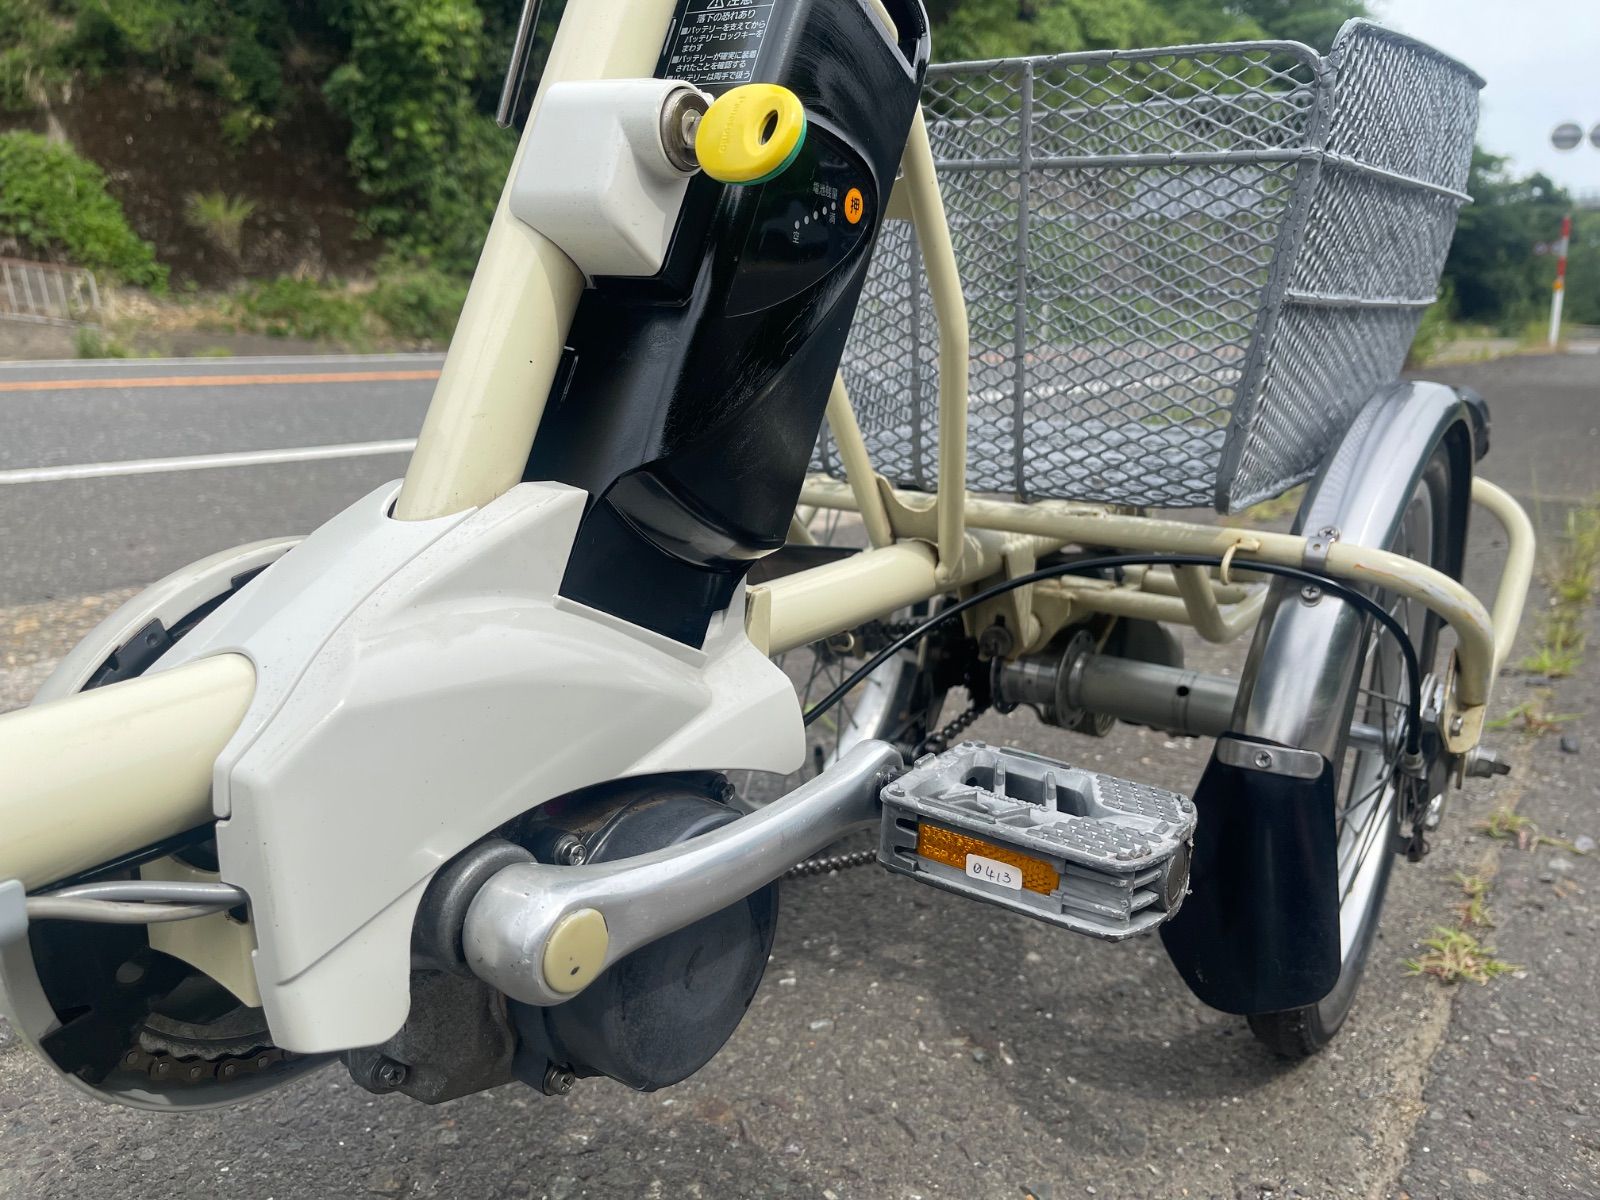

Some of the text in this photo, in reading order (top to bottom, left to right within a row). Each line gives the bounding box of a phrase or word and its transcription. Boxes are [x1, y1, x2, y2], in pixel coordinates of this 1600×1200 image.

[696, 9, 755, 23] 落下の恐れあり
[687, 20, 766, 34] バッテリーを支えてから
[684, 29, 764, 43] バッテリーロックキーを
[681, 43, 703, 53] まわす
[679, 50, 757, 63] バッテリーが確実に装着
[675, 60, 746, 72] されたことを確認する
[850, 196, 860, 215] 押
[973, 862, 1012, 884] 0413
